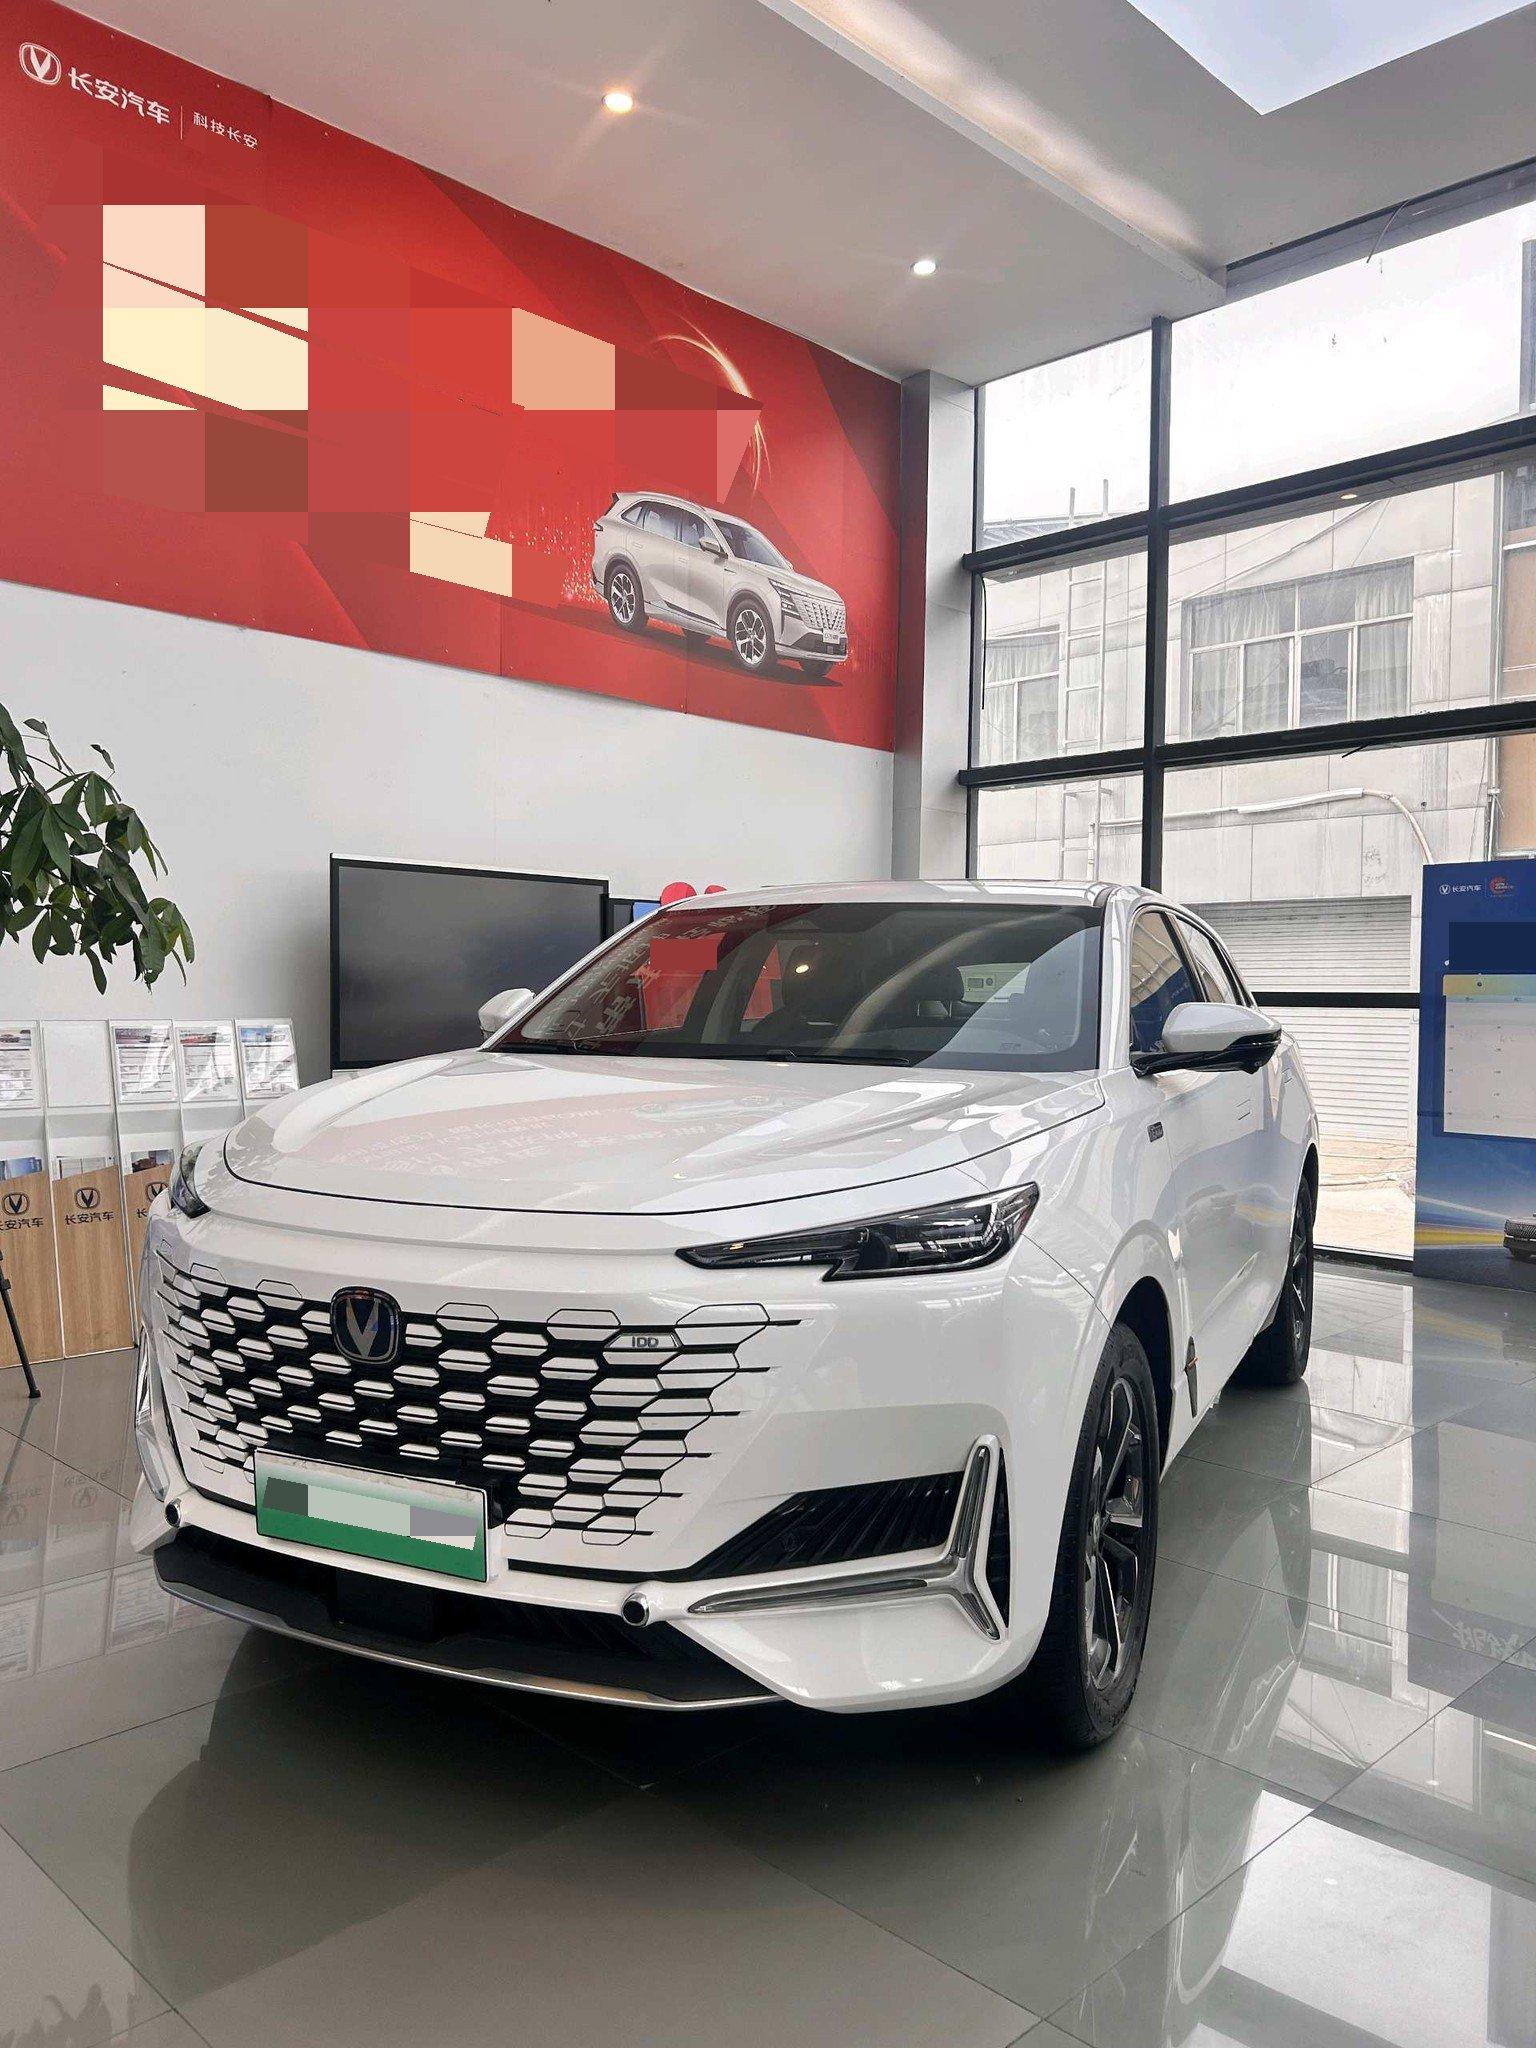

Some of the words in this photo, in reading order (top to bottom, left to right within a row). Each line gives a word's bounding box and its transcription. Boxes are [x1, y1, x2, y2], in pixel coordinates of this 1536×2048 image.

[68, 67, 170, 124] 长安汽车
[193, 112, 258, 149] 科技长安
[65, 1211, 115, 1226] 长安汽车
